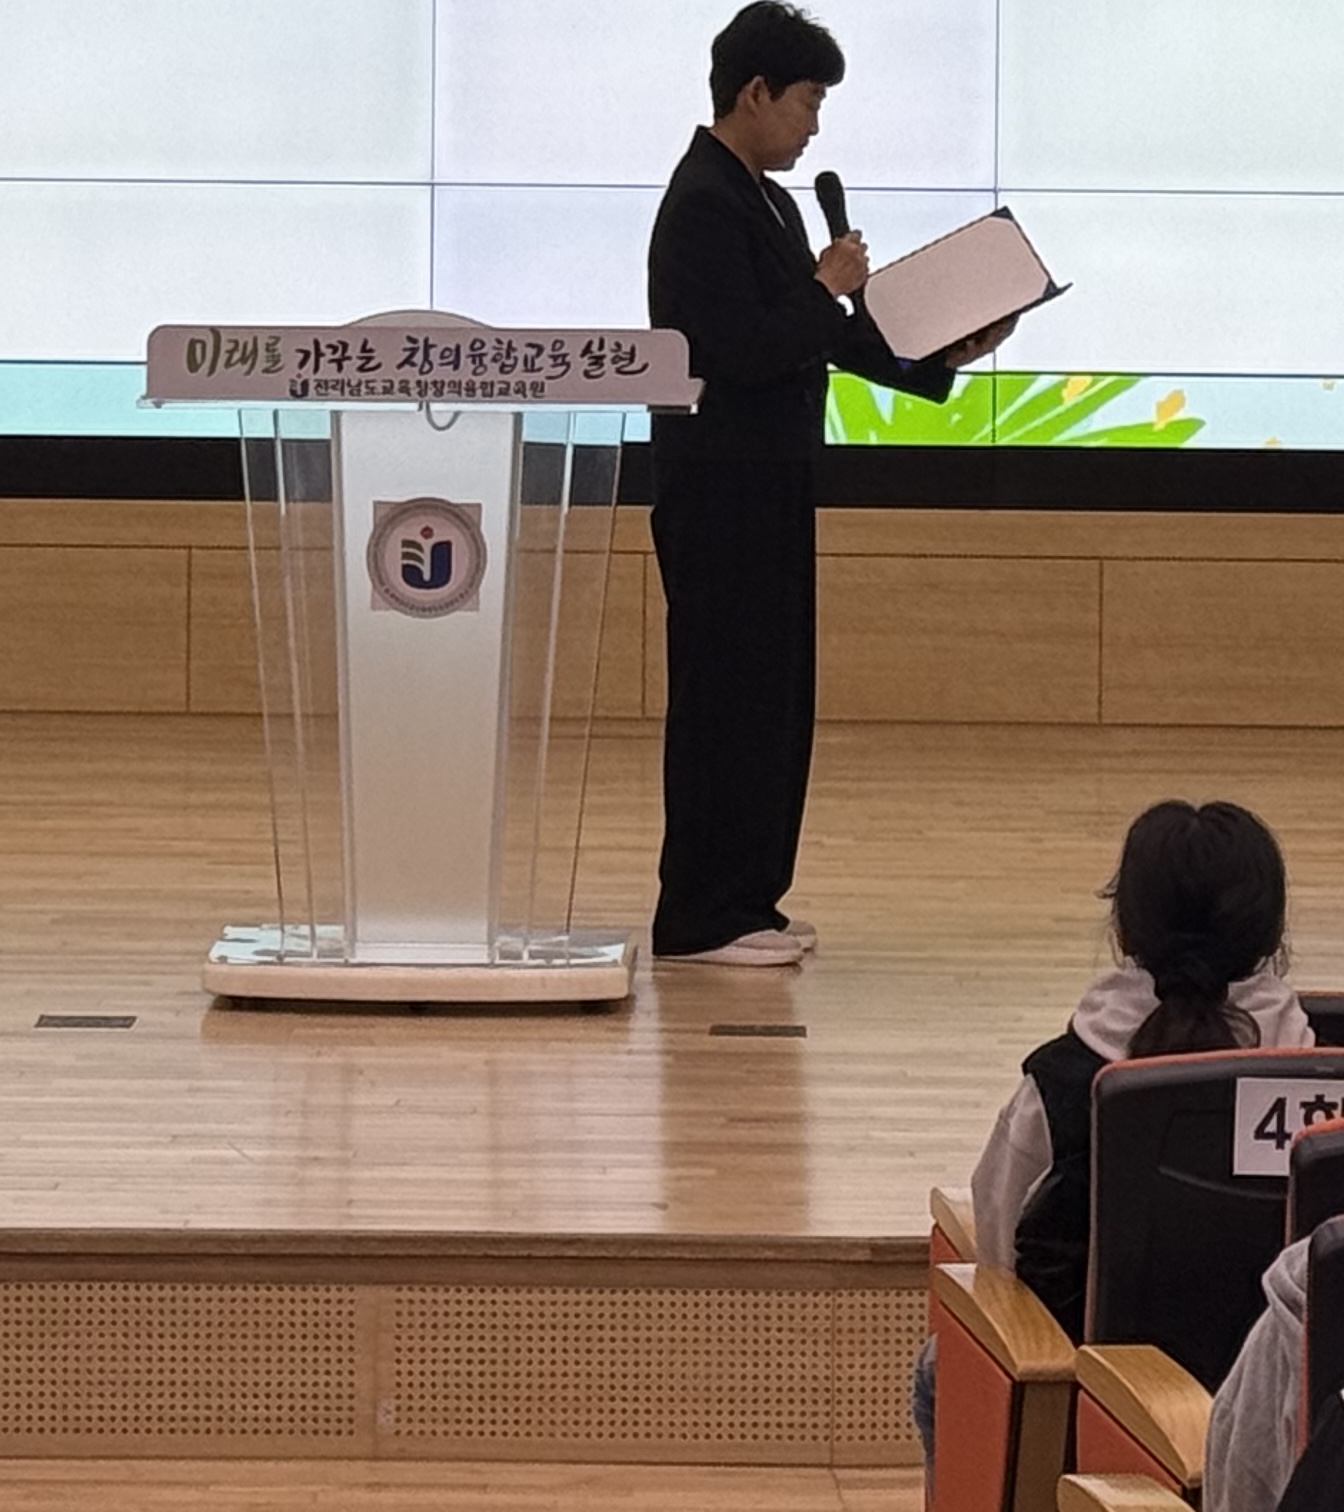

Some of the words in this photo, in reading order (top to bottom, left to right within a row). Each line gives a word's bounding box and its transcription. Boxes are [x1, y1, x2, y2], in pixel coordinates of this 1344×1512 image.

[186, 328, 285, 378] 미래를
[294, 337, 384, 375] 가꾸는
[394, 334, 573, 381] 창의융합교육
[578, 335, 650, 381] 실현
